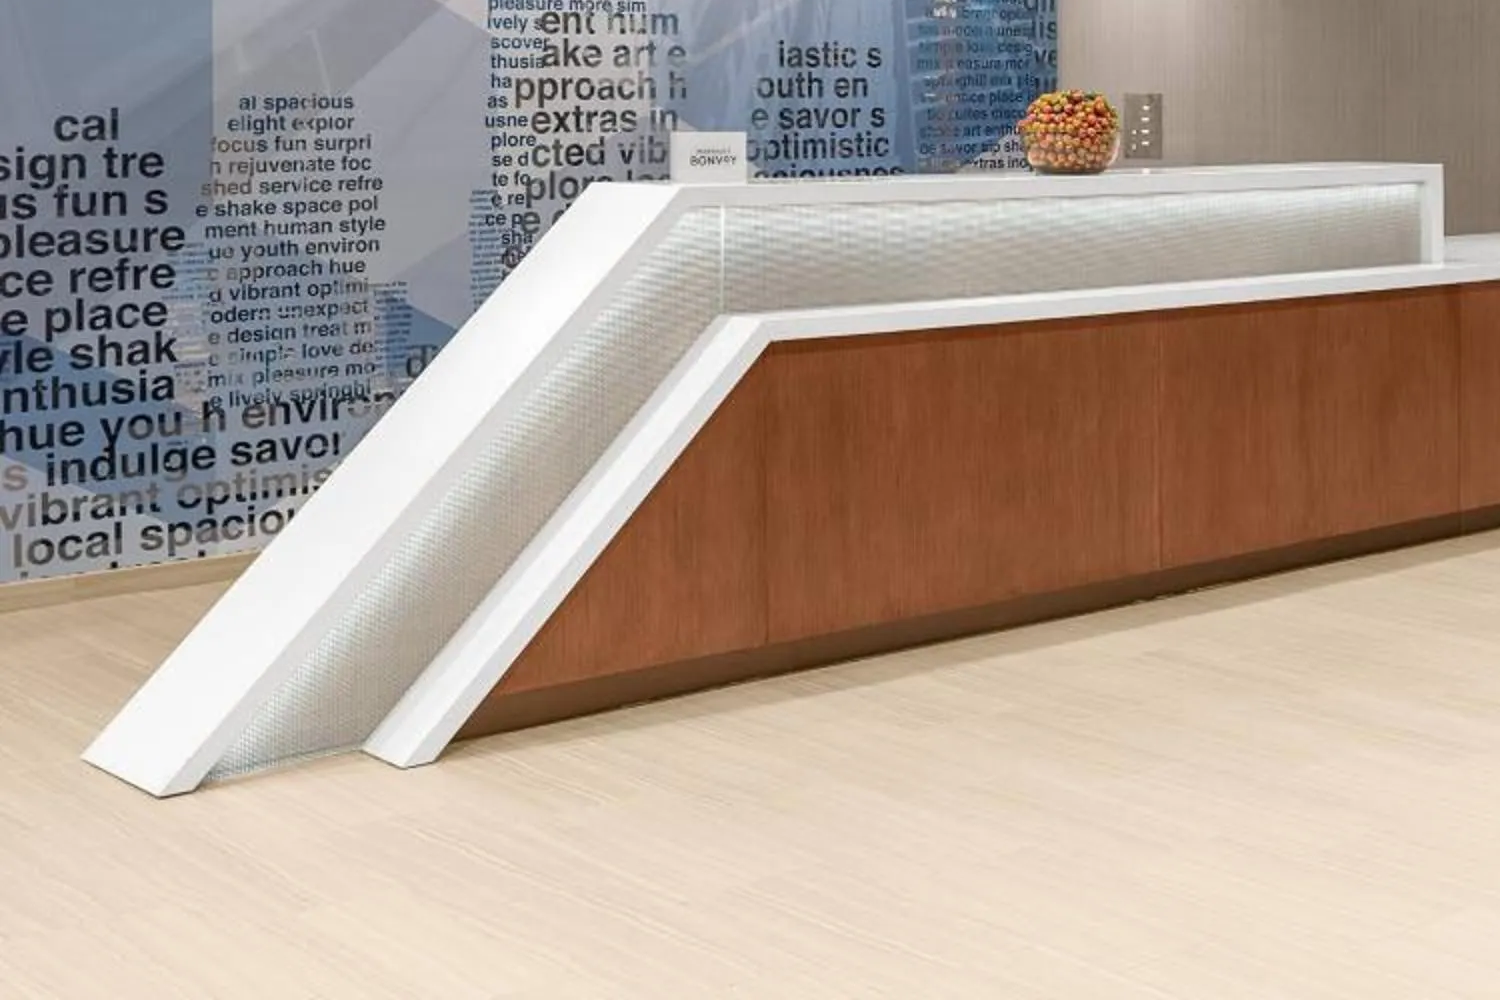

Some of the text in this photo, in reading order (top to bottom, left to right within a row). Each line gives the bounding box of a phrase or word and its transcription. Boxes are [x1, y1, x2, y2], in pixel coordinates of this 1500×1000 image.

[543, 10, 595, 35] ent
[490, 36, 548, 50] scover
[544, 39, 602, 67] ake
[613, 40, 655, 67] art
[778, 40, 882, 69] iastic s
[491, 53, 545, 69] thusia
[491, 73, 512, 88] ha
[515, 71, 656, 109] pproach
[757, 72, 868, 99] outh en
[263, 94, 355, 113] spacious
[488, 96, 508, 109] as
[54, 107, 119, 142] cal
[227, 115, 286, 135] elight
[485, 115, 528, 129] usne
[531, 105, 637, 134] extras
[752, 106, 885, 130] e savor s
[275, 136, 306, 152] fun
[314, 134, 372, 154] surpri
[491, 133, 536, 151] plore
[532, 135, 606, 167] cted
[747, 131, 889, 163] optimistic
[0, 146, 165, 190] sign tre
[229, 157, 335, 176] rejuvenate
[341, 156, 372, 171] foc
[492, 155, 513, 167] se
[201, 175, 383, 196] shed service refre
[0, 184, 168, 220] s fun s
[215, 199, 277, 217] shake
[283, 200, 343, 217] space
[349, 196, 378, 215] pol
[205, 216, 386, 238] ment human style
[240, 240, 299, 262] youth
[305, 237, 380, 255] environ
[0, 269, 54, 297] ce
[70, 258, 176, 294] refre
[226, 259, 323, 282] approach
[329, 259, 366, 274] hue
[230, 282, 300, 300] vibrant
[1, 298, 168, 342] e place
[211, 306, 271, 324] odern
[227, 325, 296, 343] design
[70, 331, 179, 371] shak
[302, 343, 344, 360] love
[3, 370, 175, 414] nthusia
[0, 411, 182, 453] hue you
[47, 442, 216, 487] indulge
[0, 481, 161, 533] vibrant
[14, 520, 122, 569] local
[141, 504, 295, 558] spacio
